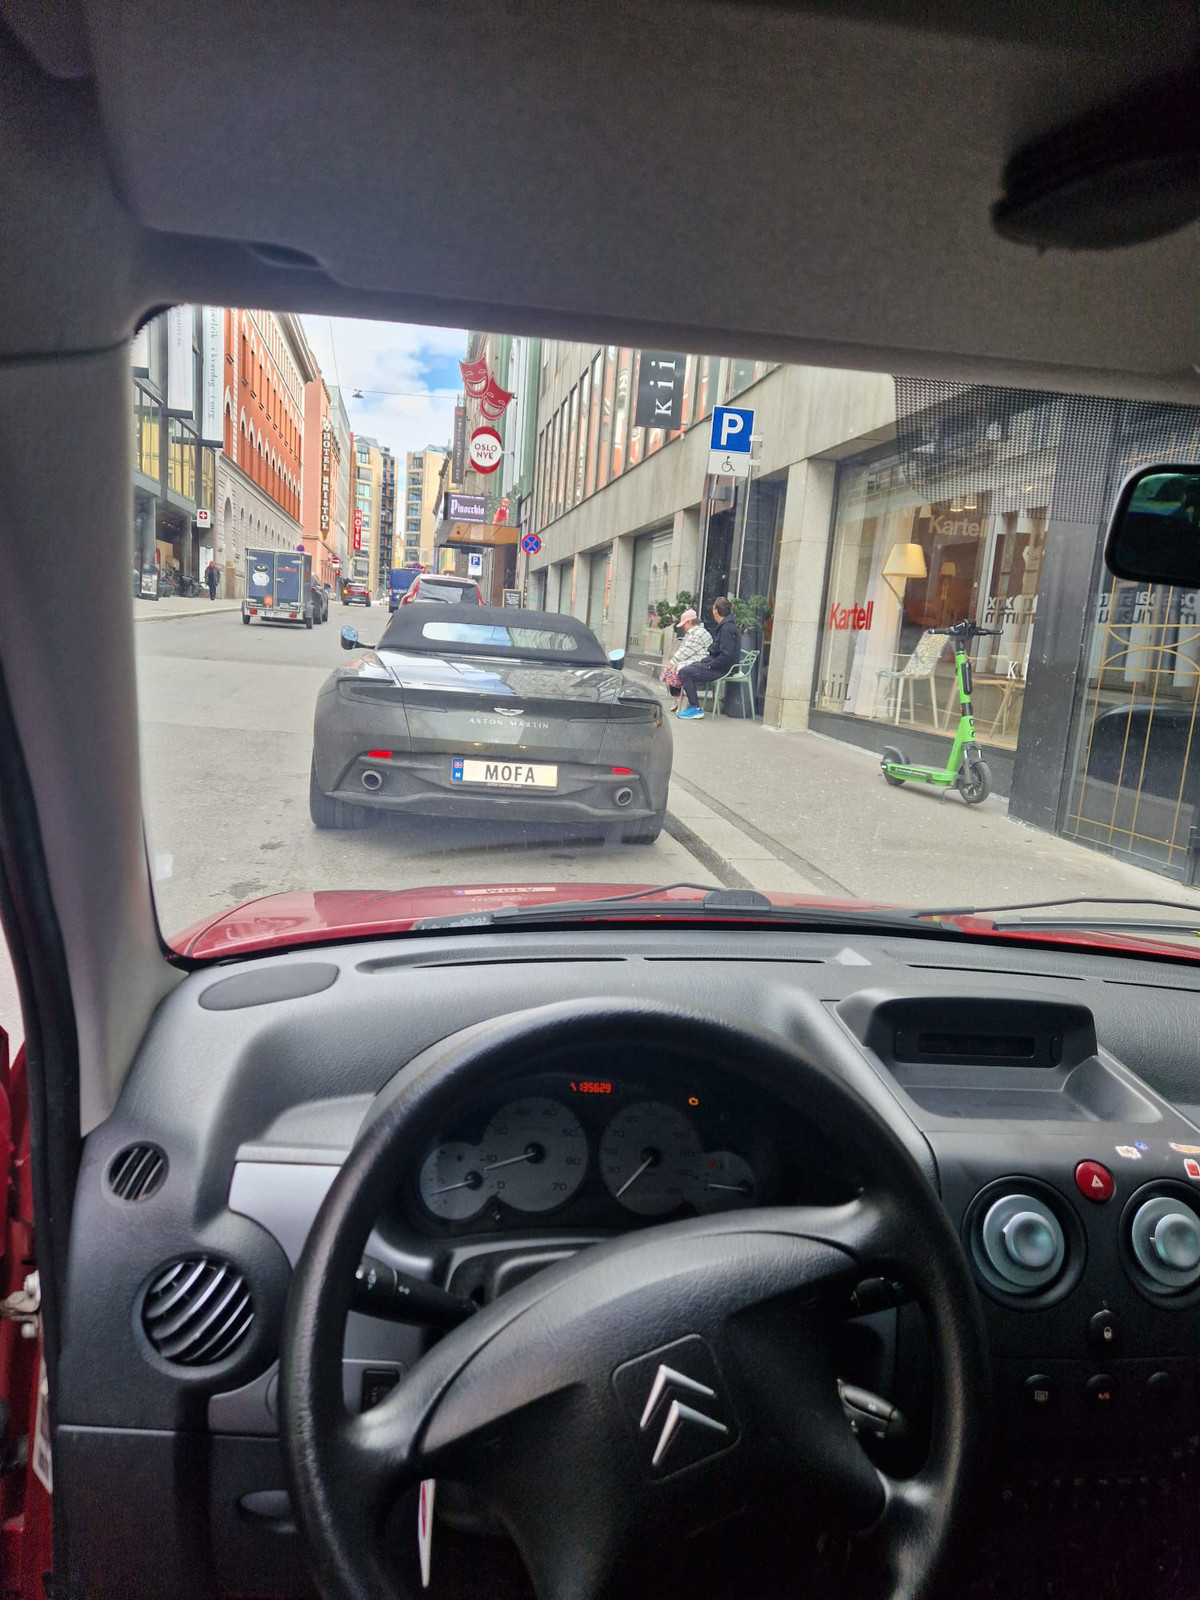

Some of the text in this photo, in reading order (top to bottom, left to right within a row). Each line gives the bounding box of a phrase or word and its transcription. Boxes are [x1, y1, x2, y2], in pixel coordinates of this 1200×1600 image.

[720, 412, 744, 446] P
[474, 443, 498, 452] OSLO
[476, 452, 494, 460] NYE
[321, 432, 330, 530] HOTEL BRISTOL
[450, 498, 485, 516] Pinocchio
[354, 511, 362, 549] HOTEL
[929, 515, 988, 538] Kartell
[472, 557, 479, 565] P
[828, 601, 874, 631] Kartell
[469, 717, 549, 729] ASTON MARTIN
[485, 764, 535, 783] MOFA
[552, 1181, 567, 1191] 70
